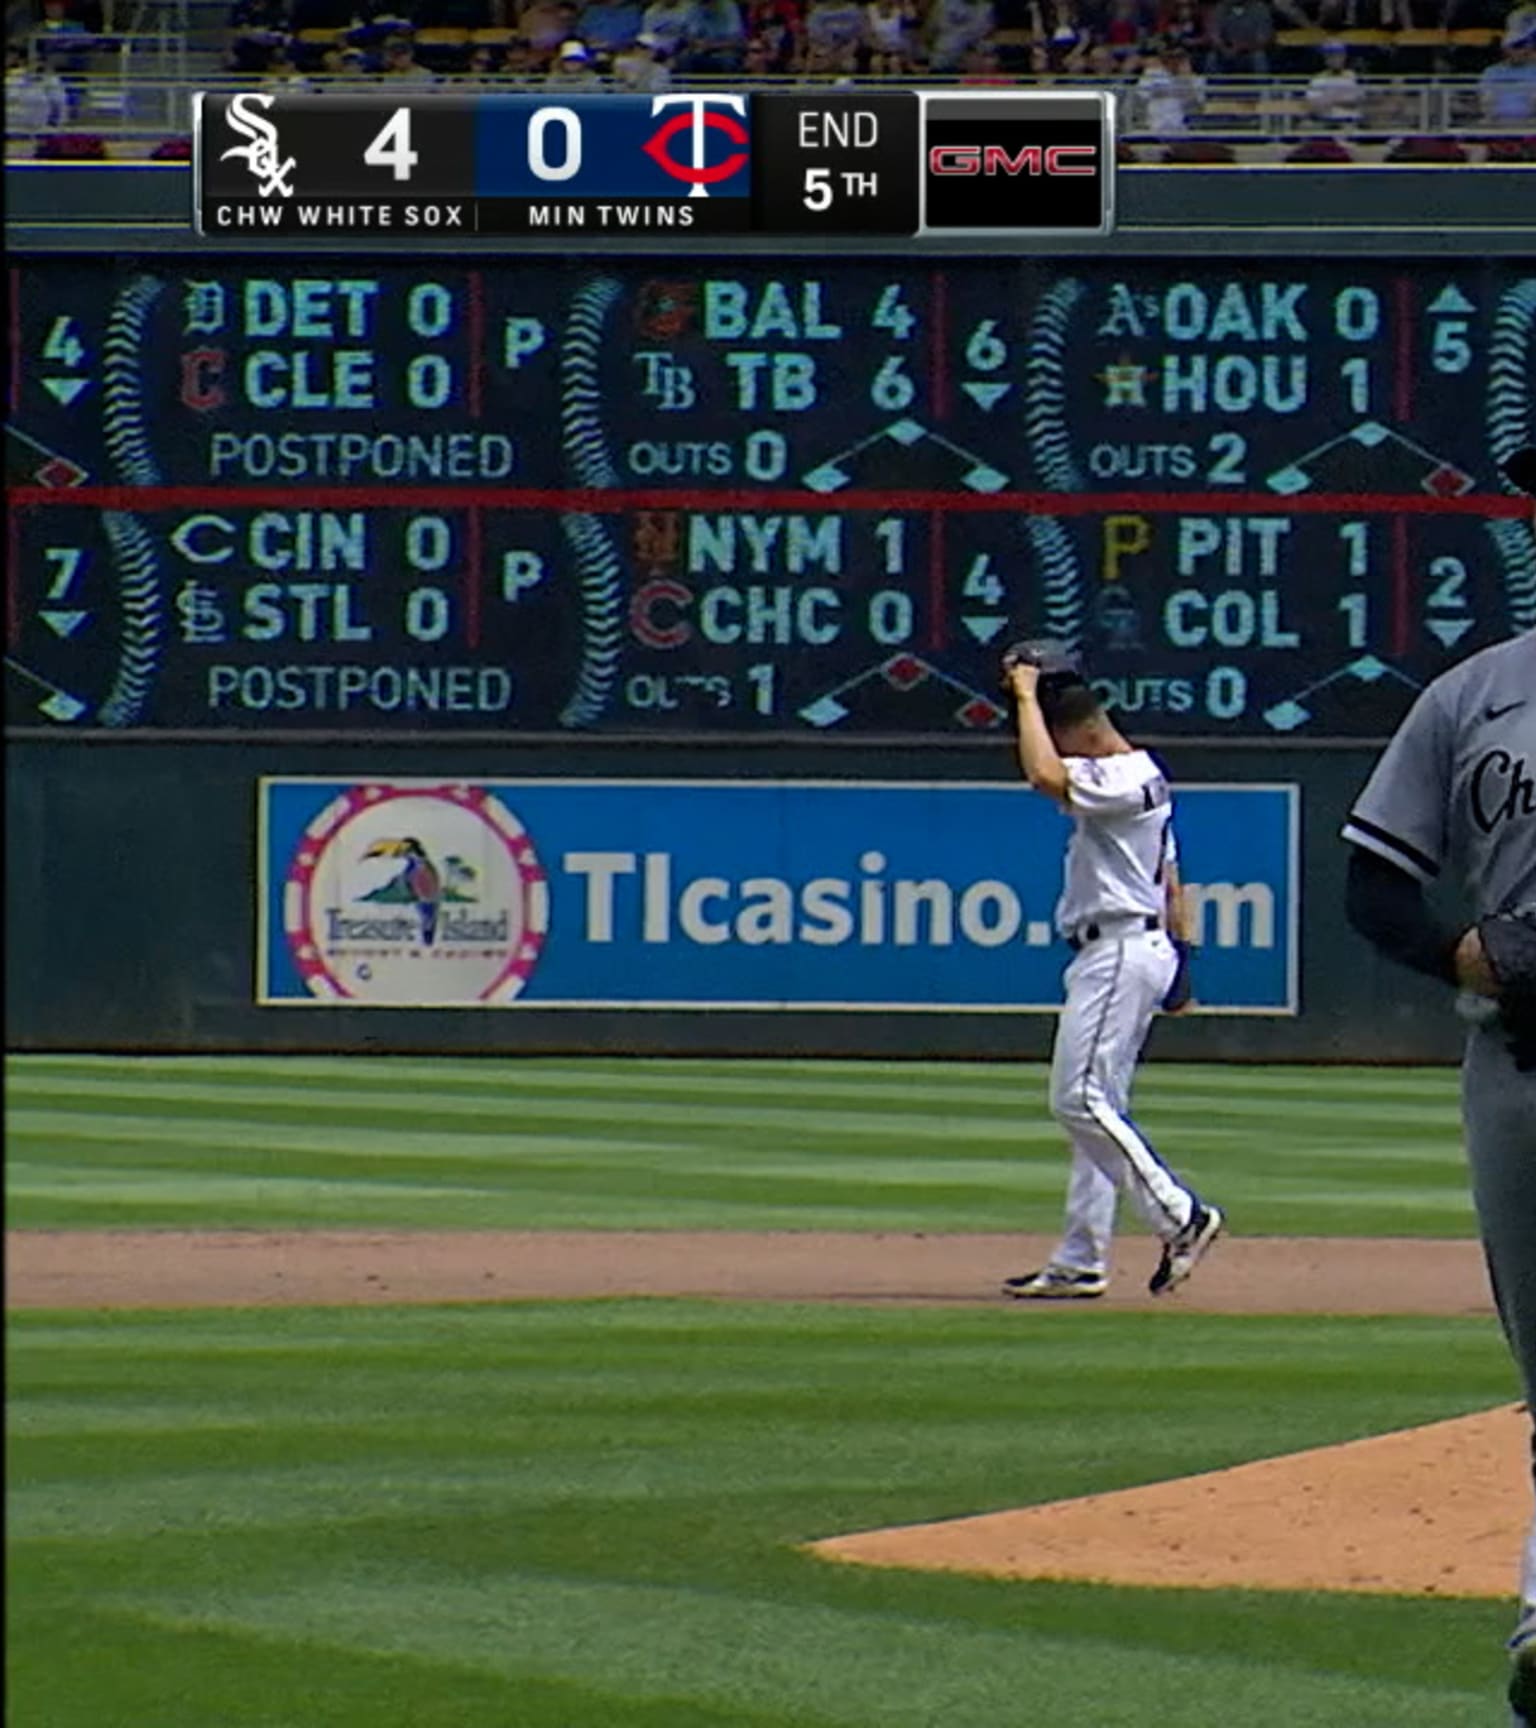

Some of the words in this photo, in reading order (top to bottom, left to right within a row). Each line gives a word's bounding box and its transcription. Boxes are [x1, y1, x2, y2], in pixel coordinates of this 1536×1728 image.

[245, 279, 378, 337] DET
[407, 283, 452, 338] 0
[704, 280, 842, 340] BAL
[872, 284, 916, 340] 4
[1163, 282, 1309, 342] OAK
[1334, 286, 1379, 342] 0
[43, 316, 84, 367] 4
[506, 317, 545, 368] P
[965, 319, 1007, 371] 6
[1431, 321, 1471, 374] 5
[245, 351, 374, 408] CLE
[407, 354, 451, 408] 0
[634, 351, 696, 411] TB
[726, 352, 817, 411] TB
[871, 357, 915, 411] 6
[1163, 355, 1307, 413] HOU
[1341, 358, 1369, 414] 1
[210, 433, 513, 477] POSTPONED
[628, 442, 732, 476] OUTS
[745, 429, 787, 481] 0
[1089, 444, 1197, 478] OUTS
[1207, 432, 1246, 484] 2
[170, 514, 236, 563] C
[249, 513, 365, 570] CIN
[406, 516, 451, 570] 0
[687, 514, 841, 574] NYM
[875, 518, 905, 574] 1
[1177, 517, 1291, 577] PIT
[1340, 522, 1368, 577] 1
[45, 548, 81, 600] 7
[503, 551, 543, 602] P
[962, 553, 1006, 605] 4
[1428, 557, 1467, 609] 2
[244, 584, 371, 641] STL
[405, 588, 450, 641] 0
[699, 586, 841, 645] CHC
[869, 591, 913, 646] 0
[1164, 590, 1300, 648] COL
[1339, 593, 1367, 648] 1
[207, 666, 511, 712] POSTPONED
[748, 664, 775, 715] 1
[1090, 677, 1194, 712] OUTS
[1206, 666, 1246, 719] 0
[563, 851, 1275, 948] TIcasino.m
